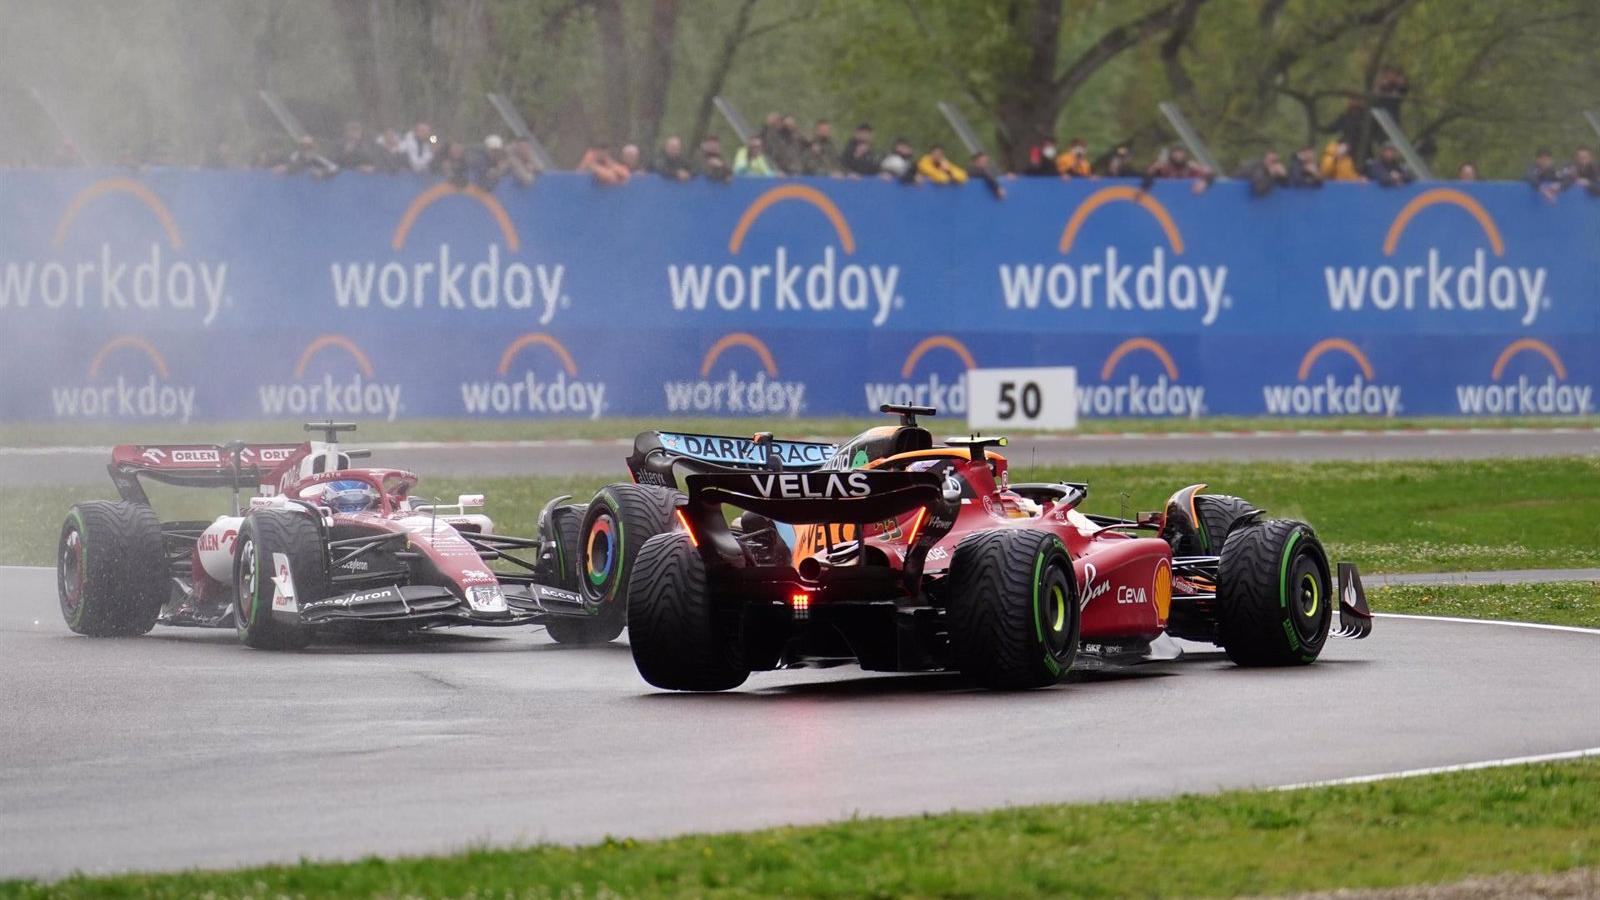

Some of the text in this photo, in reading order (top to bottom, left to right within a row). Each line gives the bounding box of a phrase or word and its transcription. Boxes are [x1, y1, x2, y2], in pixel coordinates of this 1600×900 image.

[331, 243, 564, 324] workday
[667, 245, 899, 326] workday
[999, 246, 1228, 325] workday
[1324, 248, 1547, 325] workday
[259, 374, 401, 421] workday
[461, 372, 605, 420] workday
[865, 372, 967, 414] workd
[997, 382, 1042, 420] 50
[1263, 375, 1400, 416] workday
[1456, 375, 1592, 416] workday
[175, 452, 216, 460] ORLEN
[751, 473, 871, 498] VELAS
